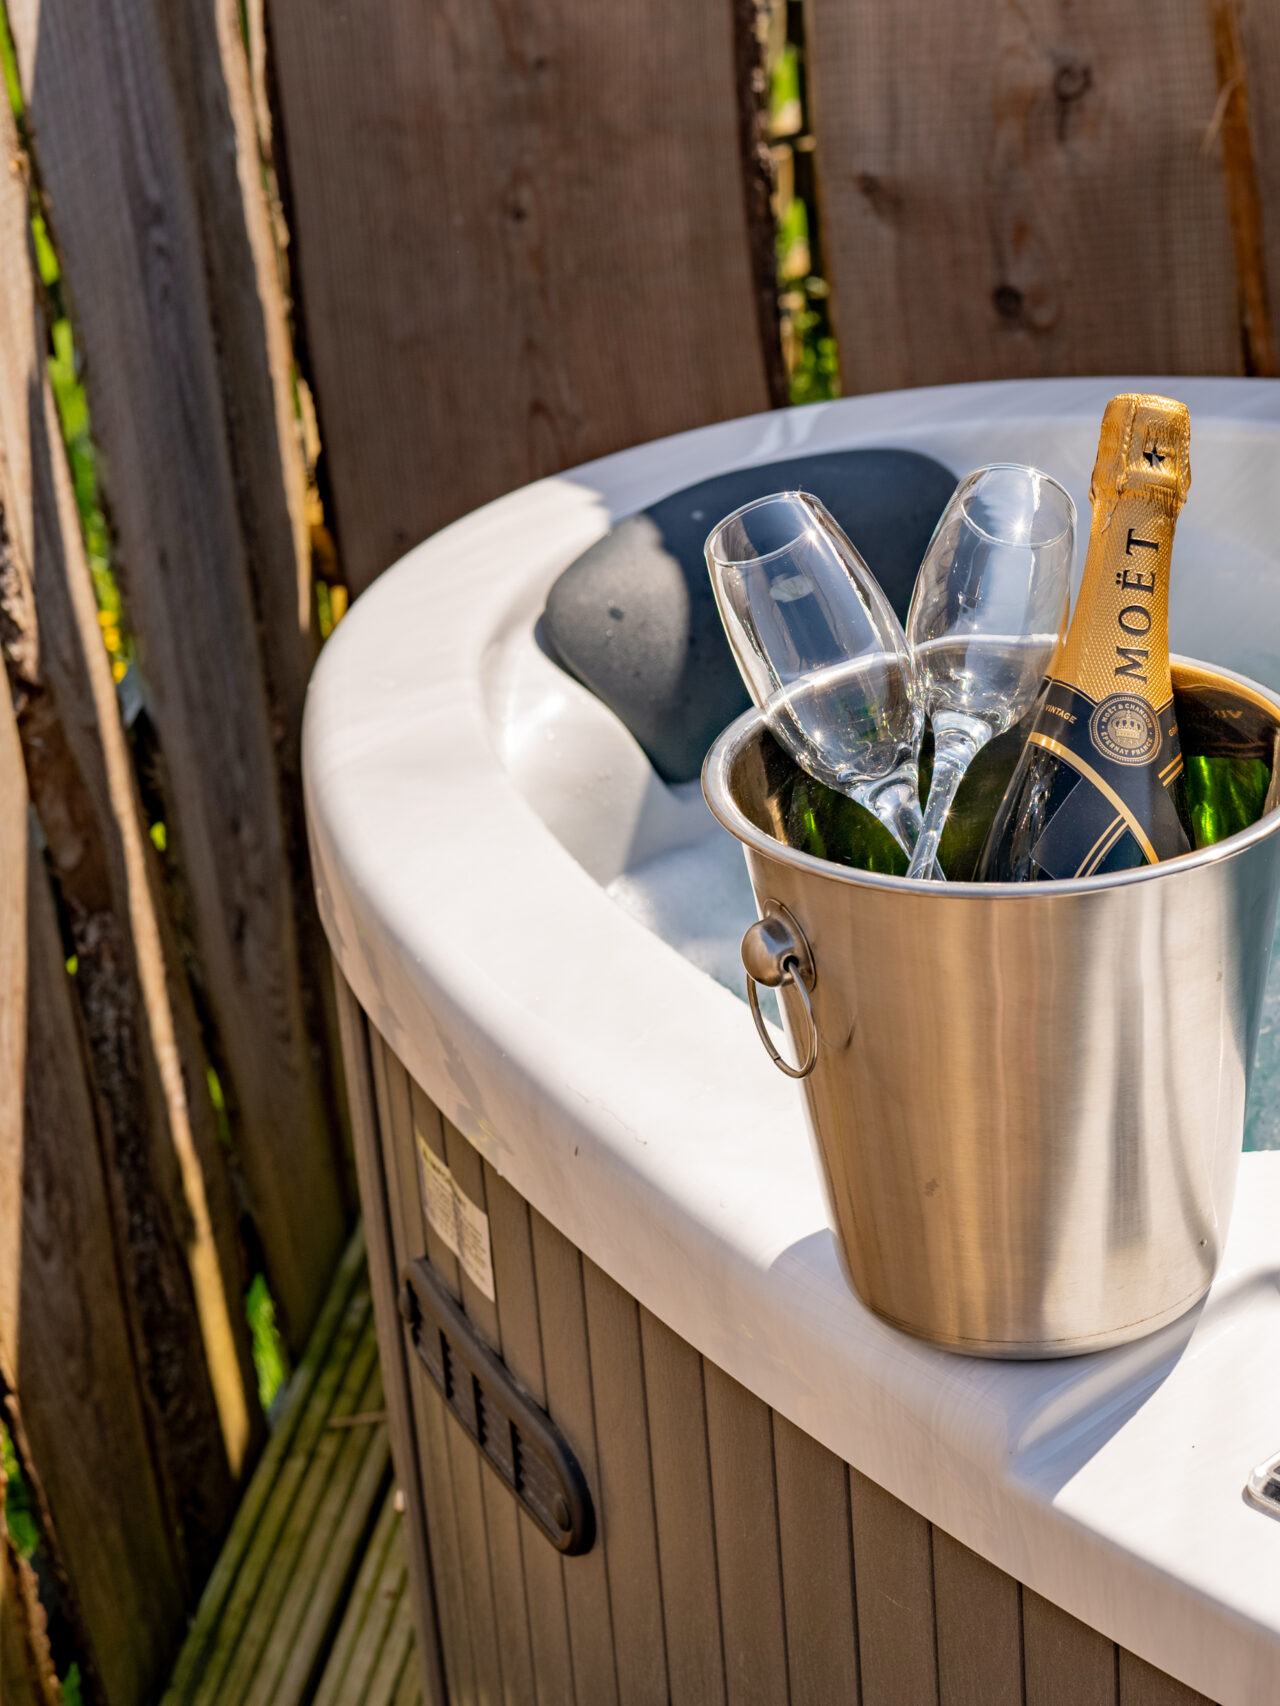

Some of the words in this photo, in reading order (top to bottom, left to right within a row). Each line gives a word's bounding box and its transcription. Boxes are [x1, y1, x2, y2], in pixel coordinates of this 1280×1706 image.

[1114, 528, 1159, 684] MOËT
[1045, 704, 1077, 724] VINTAGE
[1125, 703, 1153, 728] CHANDON
[1131, 737, 1153, 756] FRANCE
